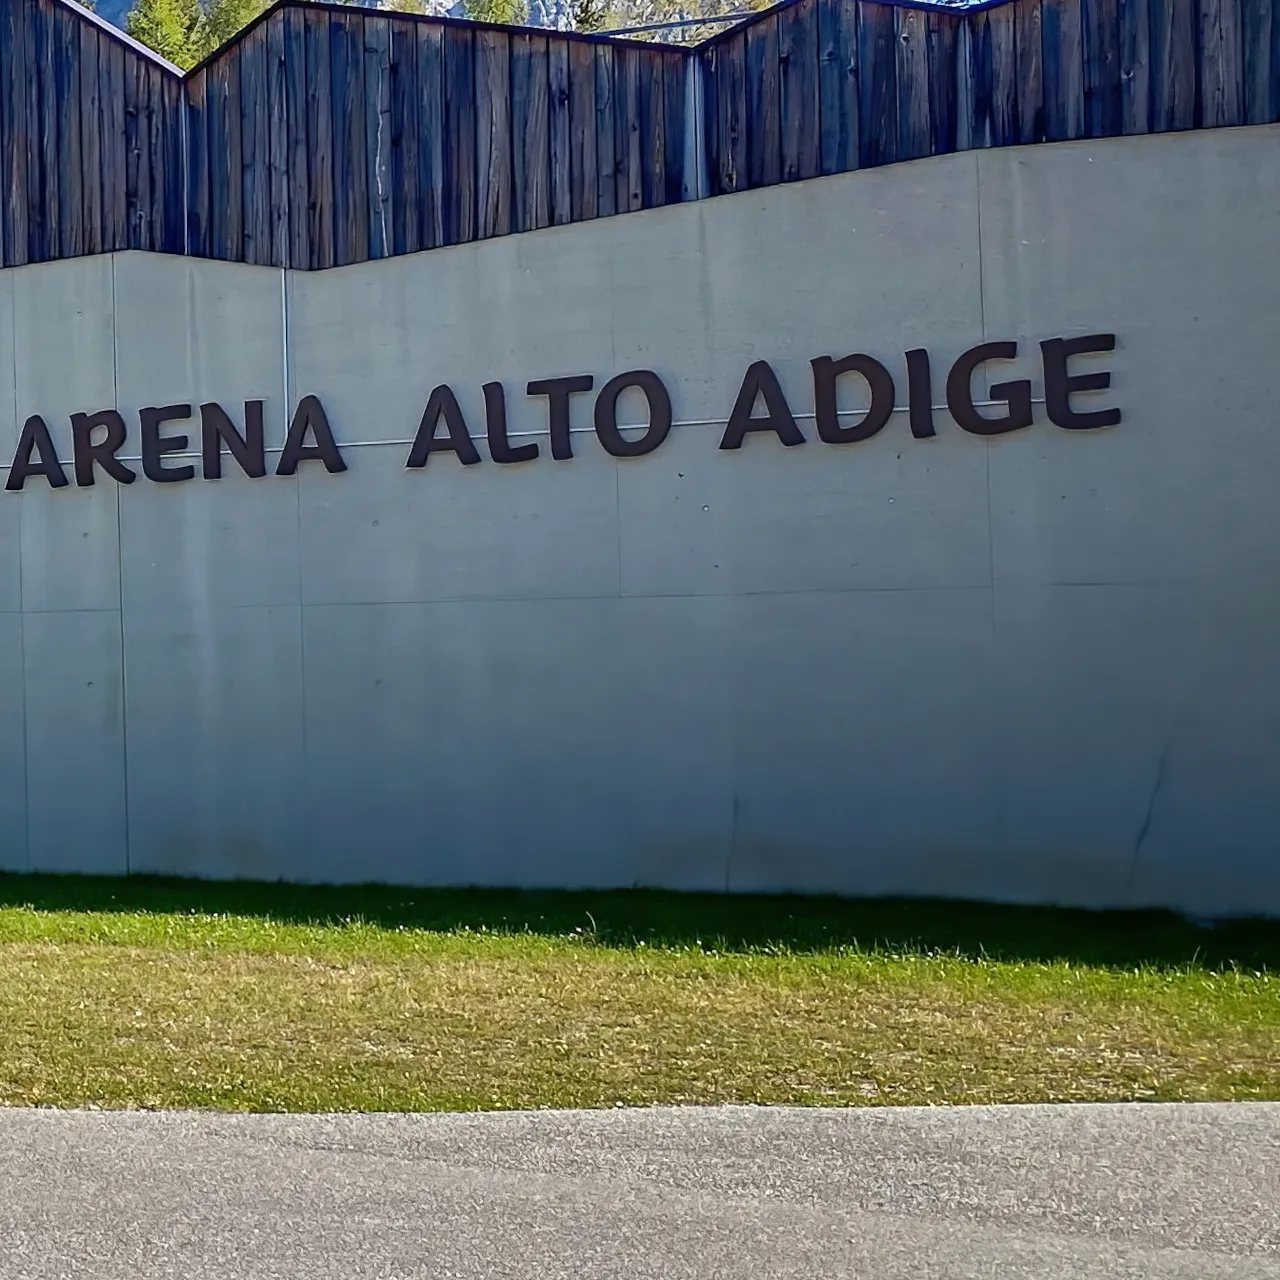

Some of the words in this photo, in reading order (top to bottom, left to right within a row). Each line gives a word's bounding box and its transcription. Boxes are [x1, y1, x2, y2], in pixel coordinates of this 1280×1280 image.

[4, 394, 348, 492] ARENA
[405, 369, 673, 469] ALTO
[719, 333, 1123, 450] ADIGE
